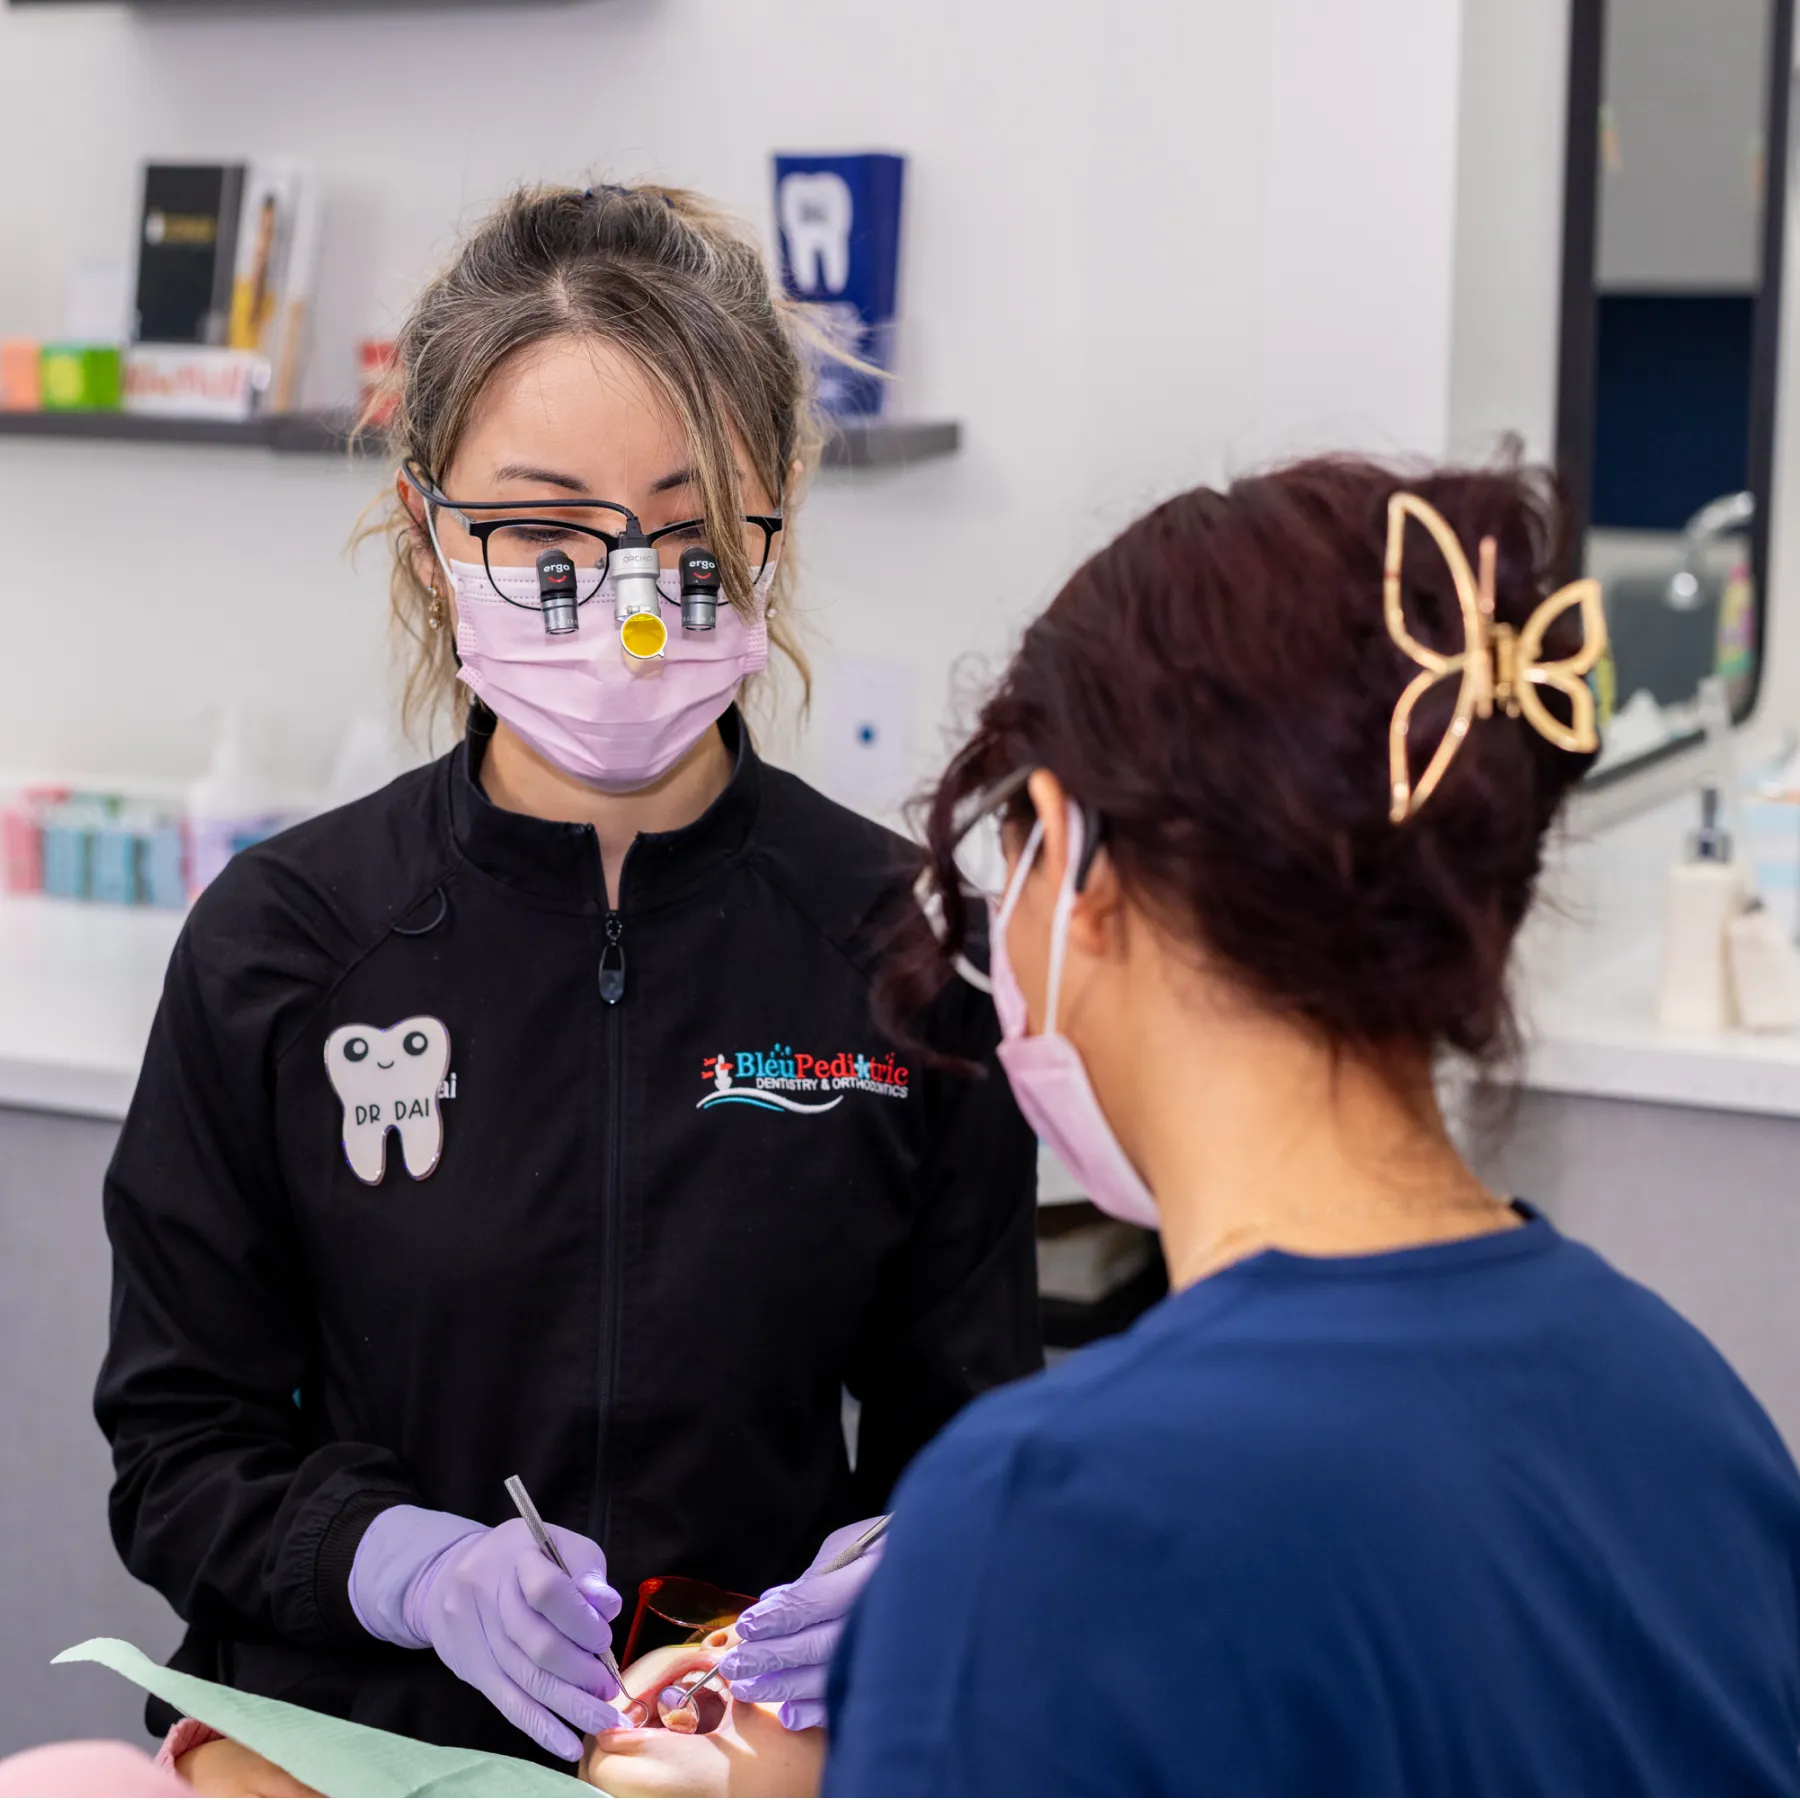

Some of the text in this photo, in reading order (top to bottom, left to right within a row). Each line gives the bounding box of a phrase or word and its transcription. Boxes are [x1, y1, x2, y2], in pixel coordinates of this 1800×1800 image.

[543, 563, 571, 573] ergo
[688, 560, 716, 570] ergo
[755, 1077, 819, 1091] DENTISTRY
[820, 1079, 831, 1091] &
[355, 1098, 430, 1126] DR DAI
